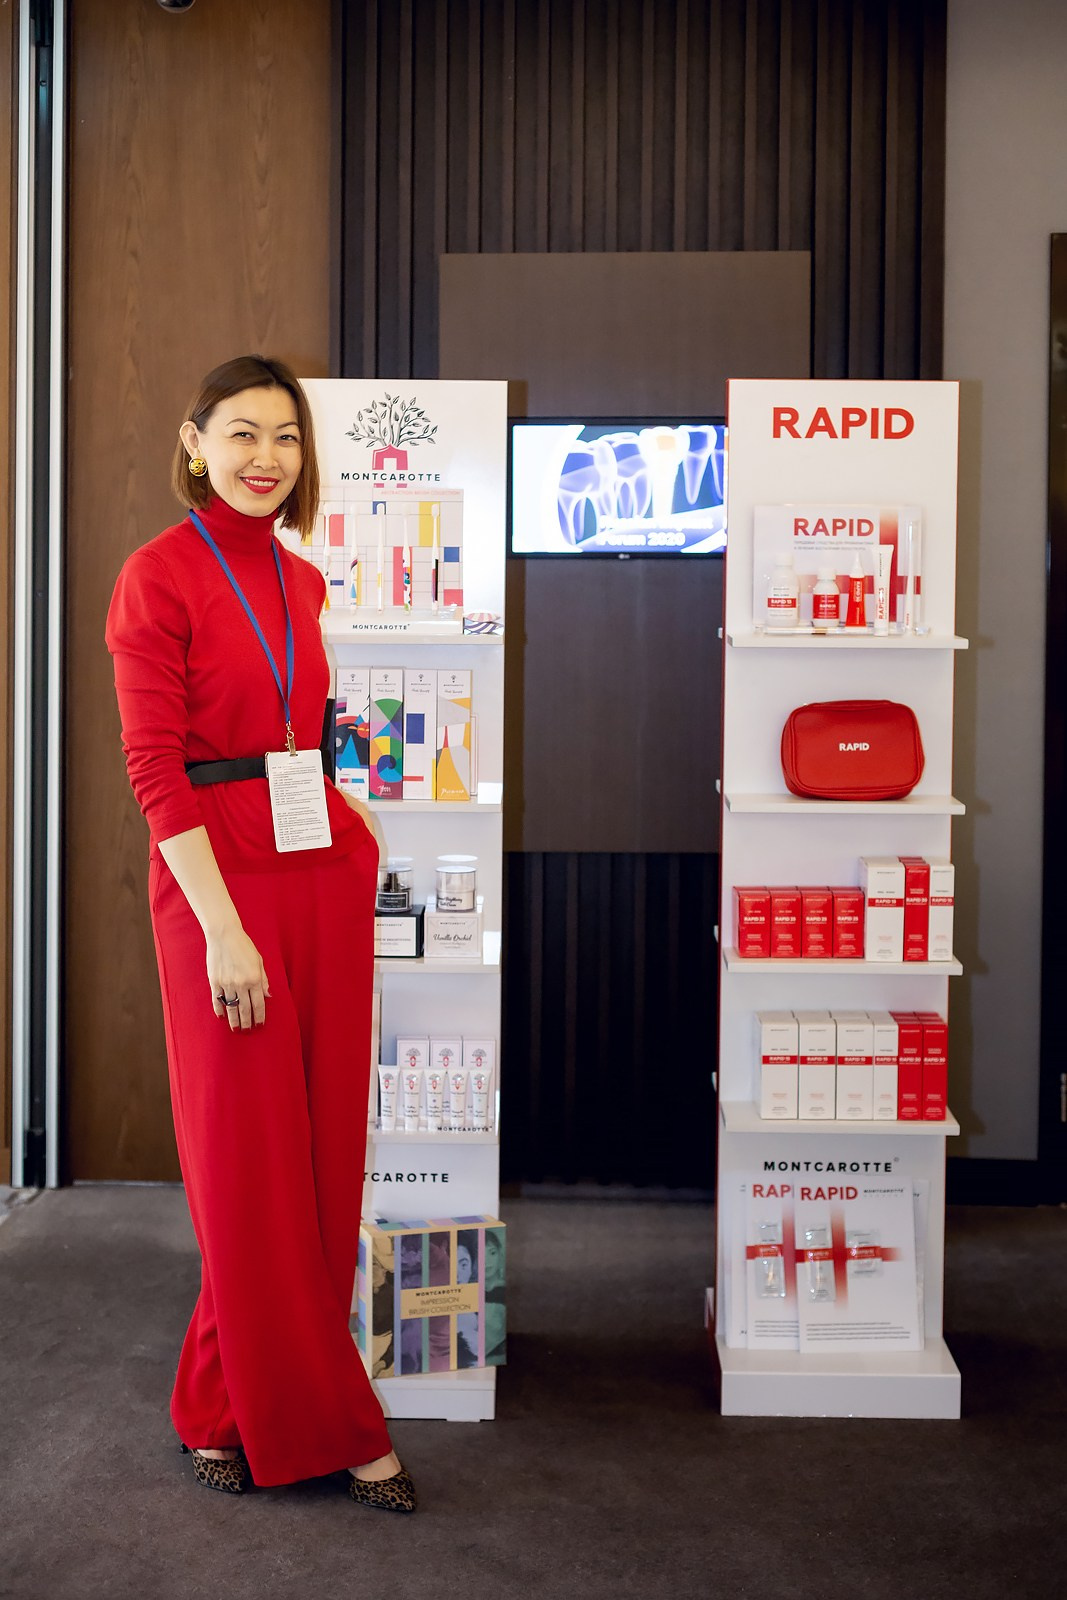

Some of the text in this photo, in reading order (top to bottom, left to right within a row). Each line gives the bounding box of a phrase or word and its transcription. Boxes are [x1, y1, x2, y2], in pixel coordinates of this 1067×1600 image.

[772, 406, 915, 440] RAPID
[340, 472, 441, 482] MONTCAROTTE
[793, 517, 875, 537] RAPID
[838, 742, 870, 751] RAPID
[764, 1161, 892, 1173] MONTCAROTTE
[752, 1184, 793, 1198] RAP
[800, 1186, 858, 1201] RAPID
[415, 1289, 462, 1297] MONTCAROTTE
[420, 1297, 459, 1306] IMPRESSION
[409, 1304, 471, 1316] BRUSH COLLECTION
